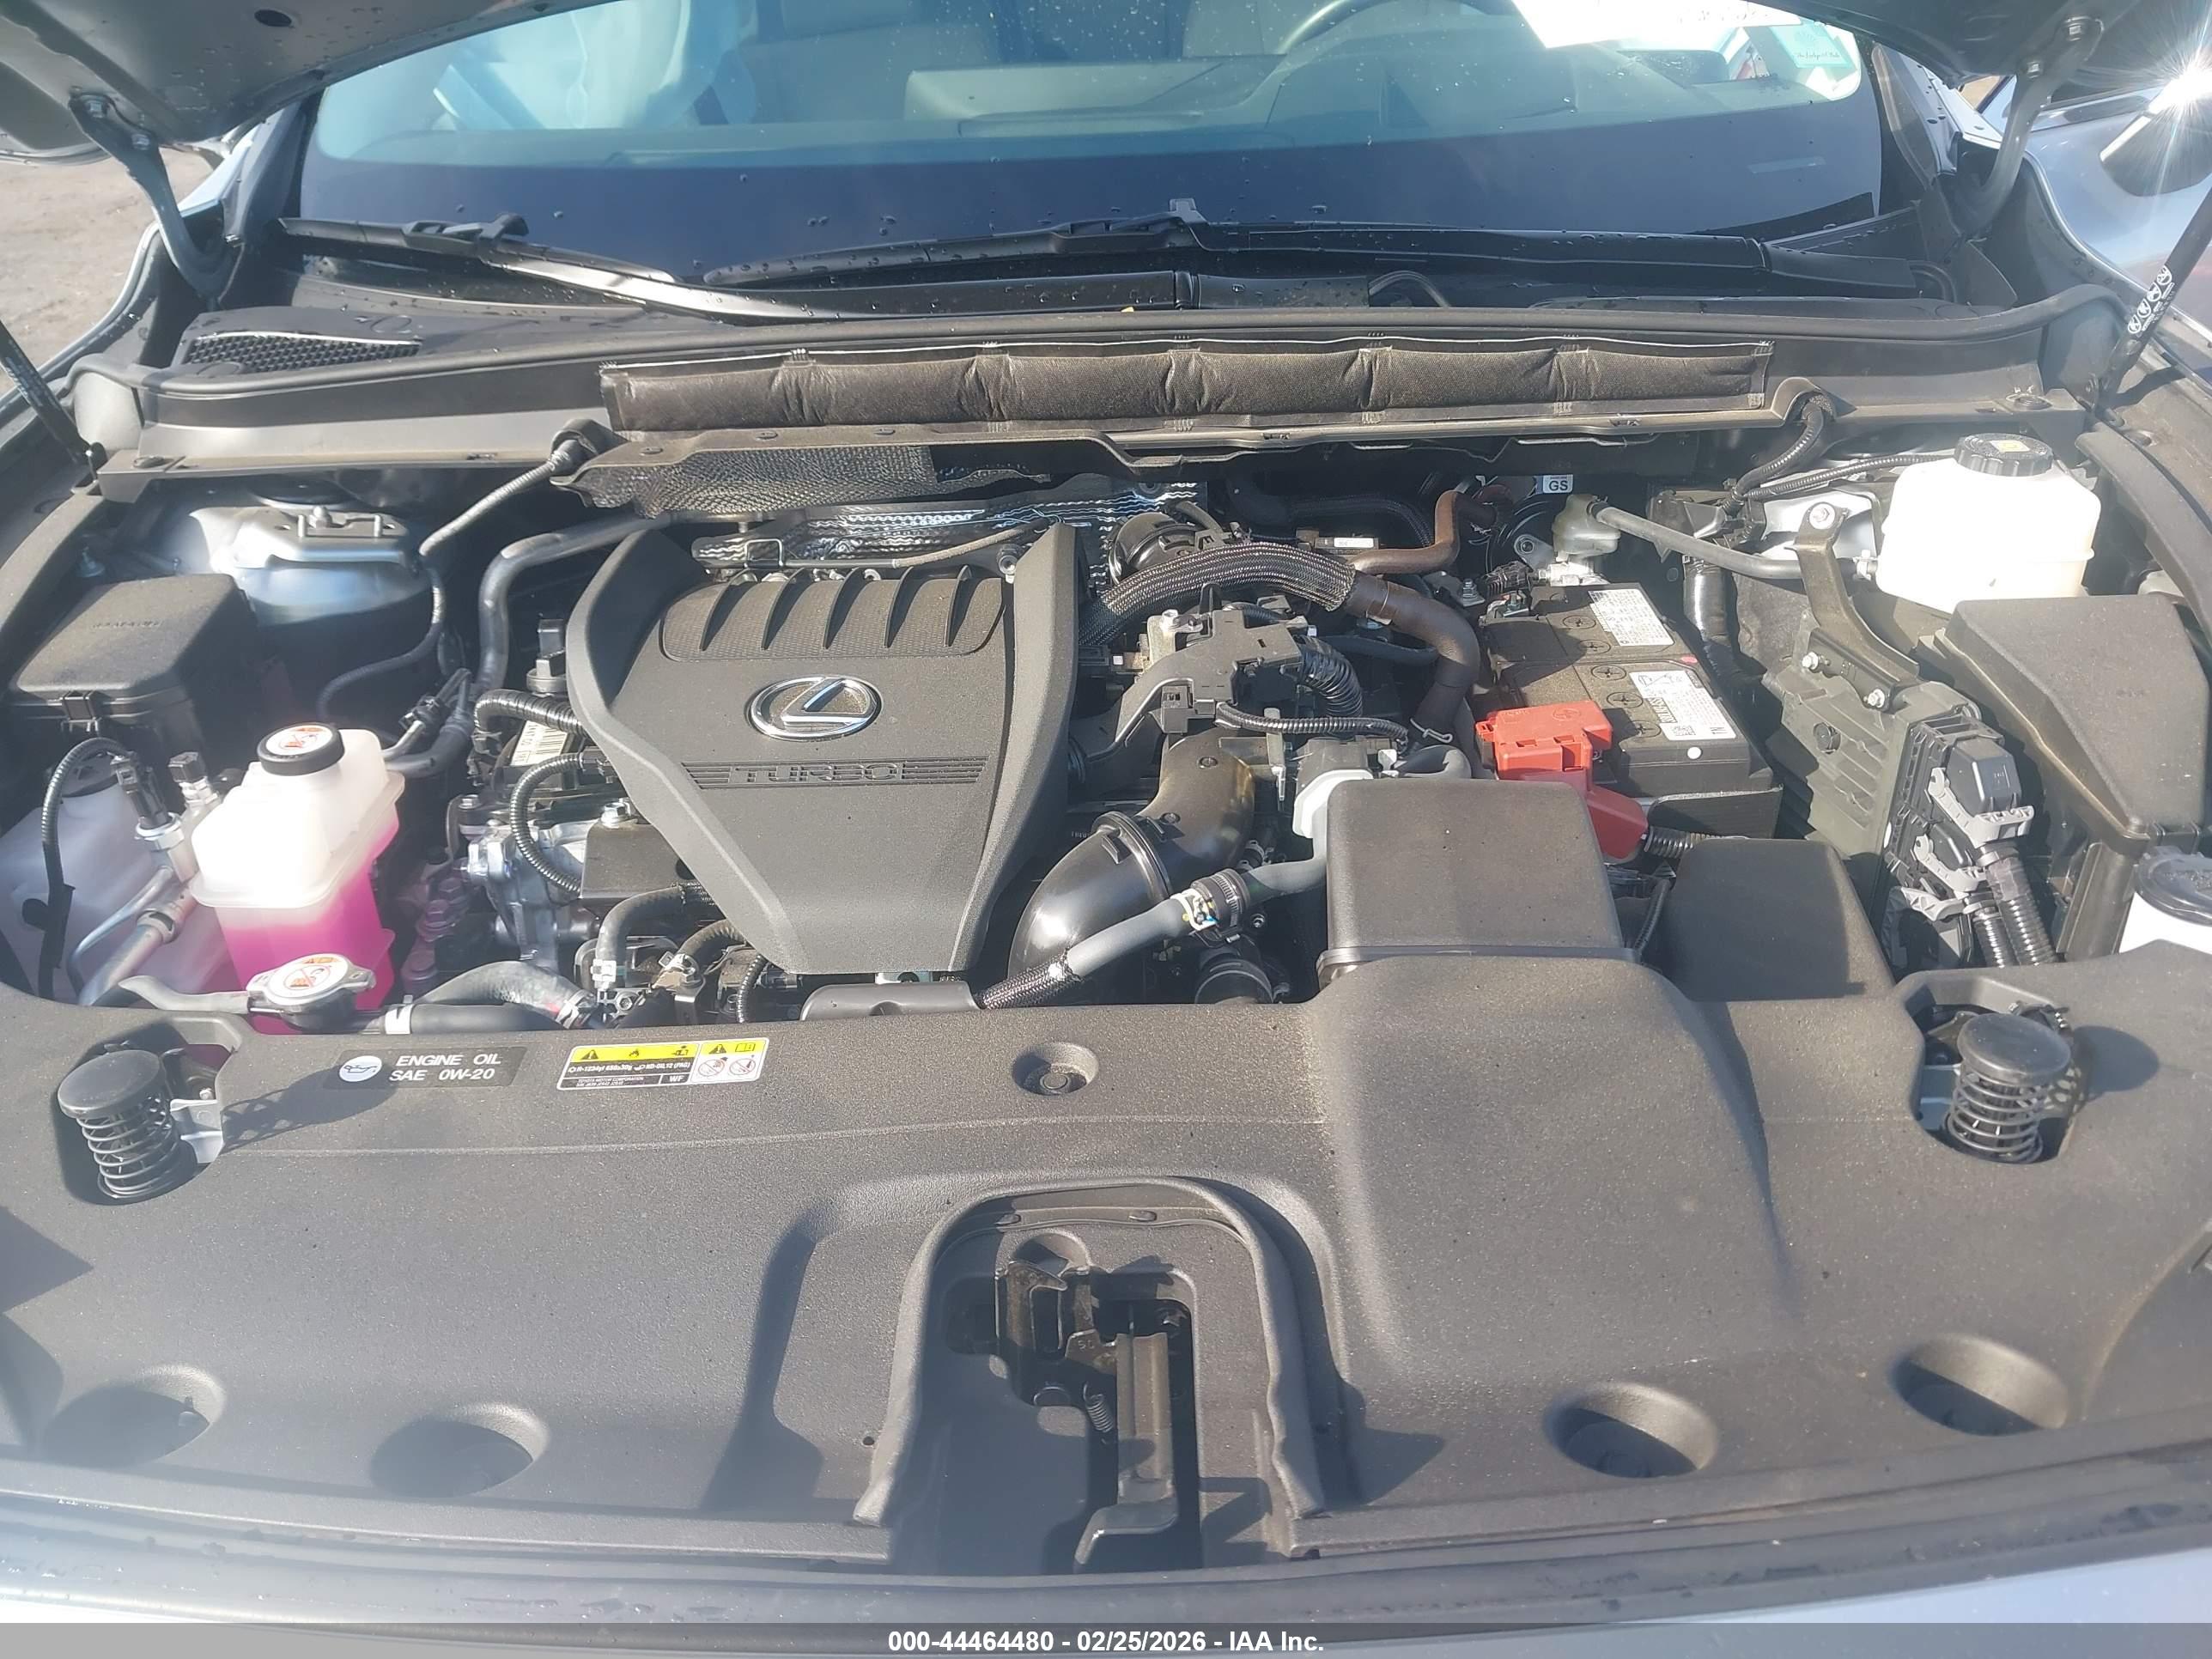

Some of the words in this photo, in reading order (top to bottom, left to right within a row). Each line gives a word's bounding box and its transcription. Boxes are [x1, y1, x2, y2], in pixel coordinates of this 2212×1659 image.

[1548, 480, 1568, 491] GS
[735, 763, 898, 783] TURBO
[396, 1054, 464, 1066] ENGINE
[473, 1053, 501, 1066] OIL
[389, 1069, 428, 1081] SAE
[438, 1068, 495, 1080] 0W-20
